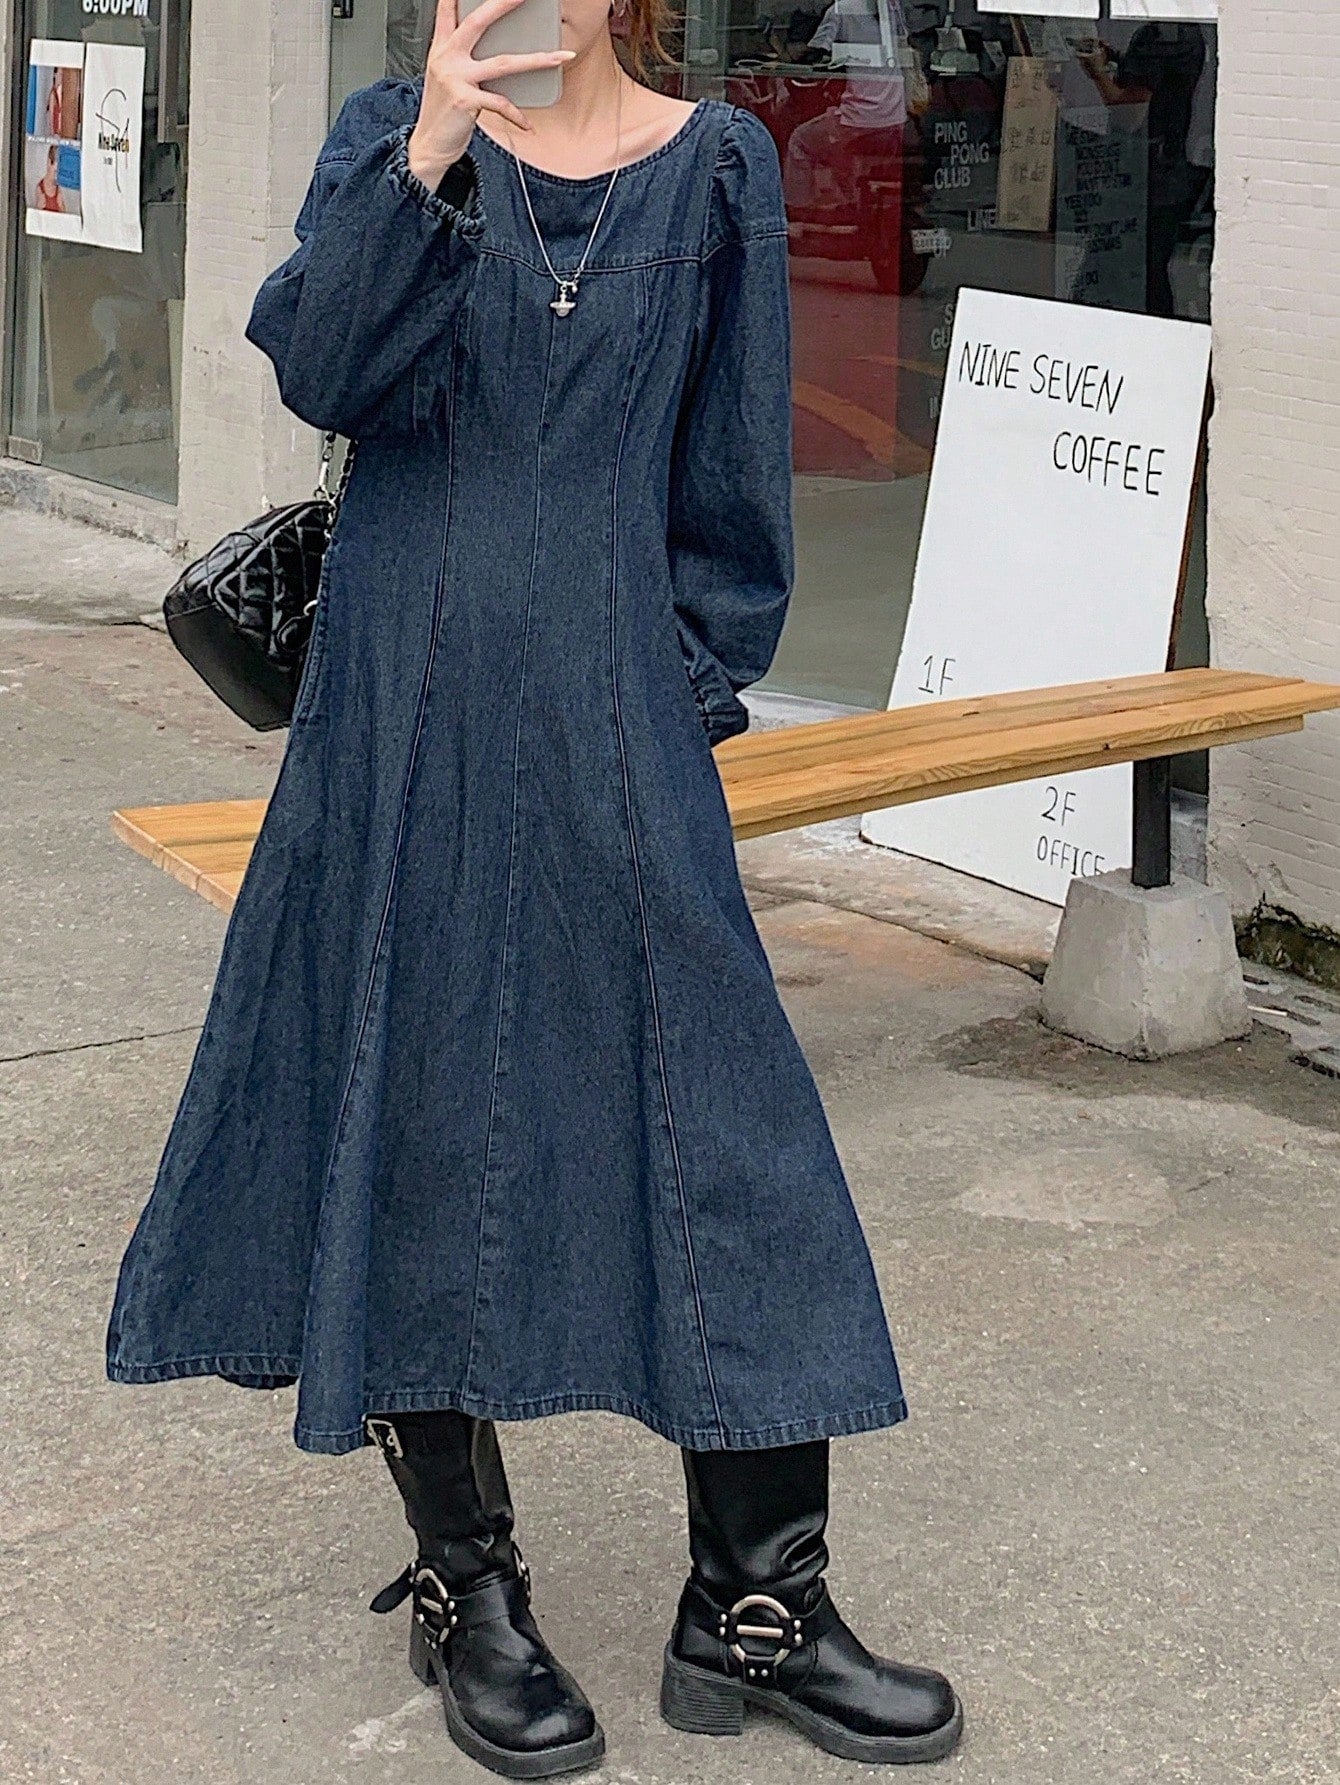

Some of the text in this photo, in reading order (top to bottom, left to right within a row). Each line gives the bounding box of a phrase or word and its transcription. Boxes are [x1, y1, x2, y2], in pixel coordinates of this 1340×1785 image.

[934, 121, 967, 144] PING
[949, 142, 990, 165] PONG
[934, 166, 971, 190] CLUB
[958, 341, 1124, 415] NINE SEVEN
[1053, 431, 1165, 496] COFFEE
[918, 654, 956, 696] 1F
[1041, 786, 1077, 827] 2F
[1036, 835, 1106, 878] OFFICE
